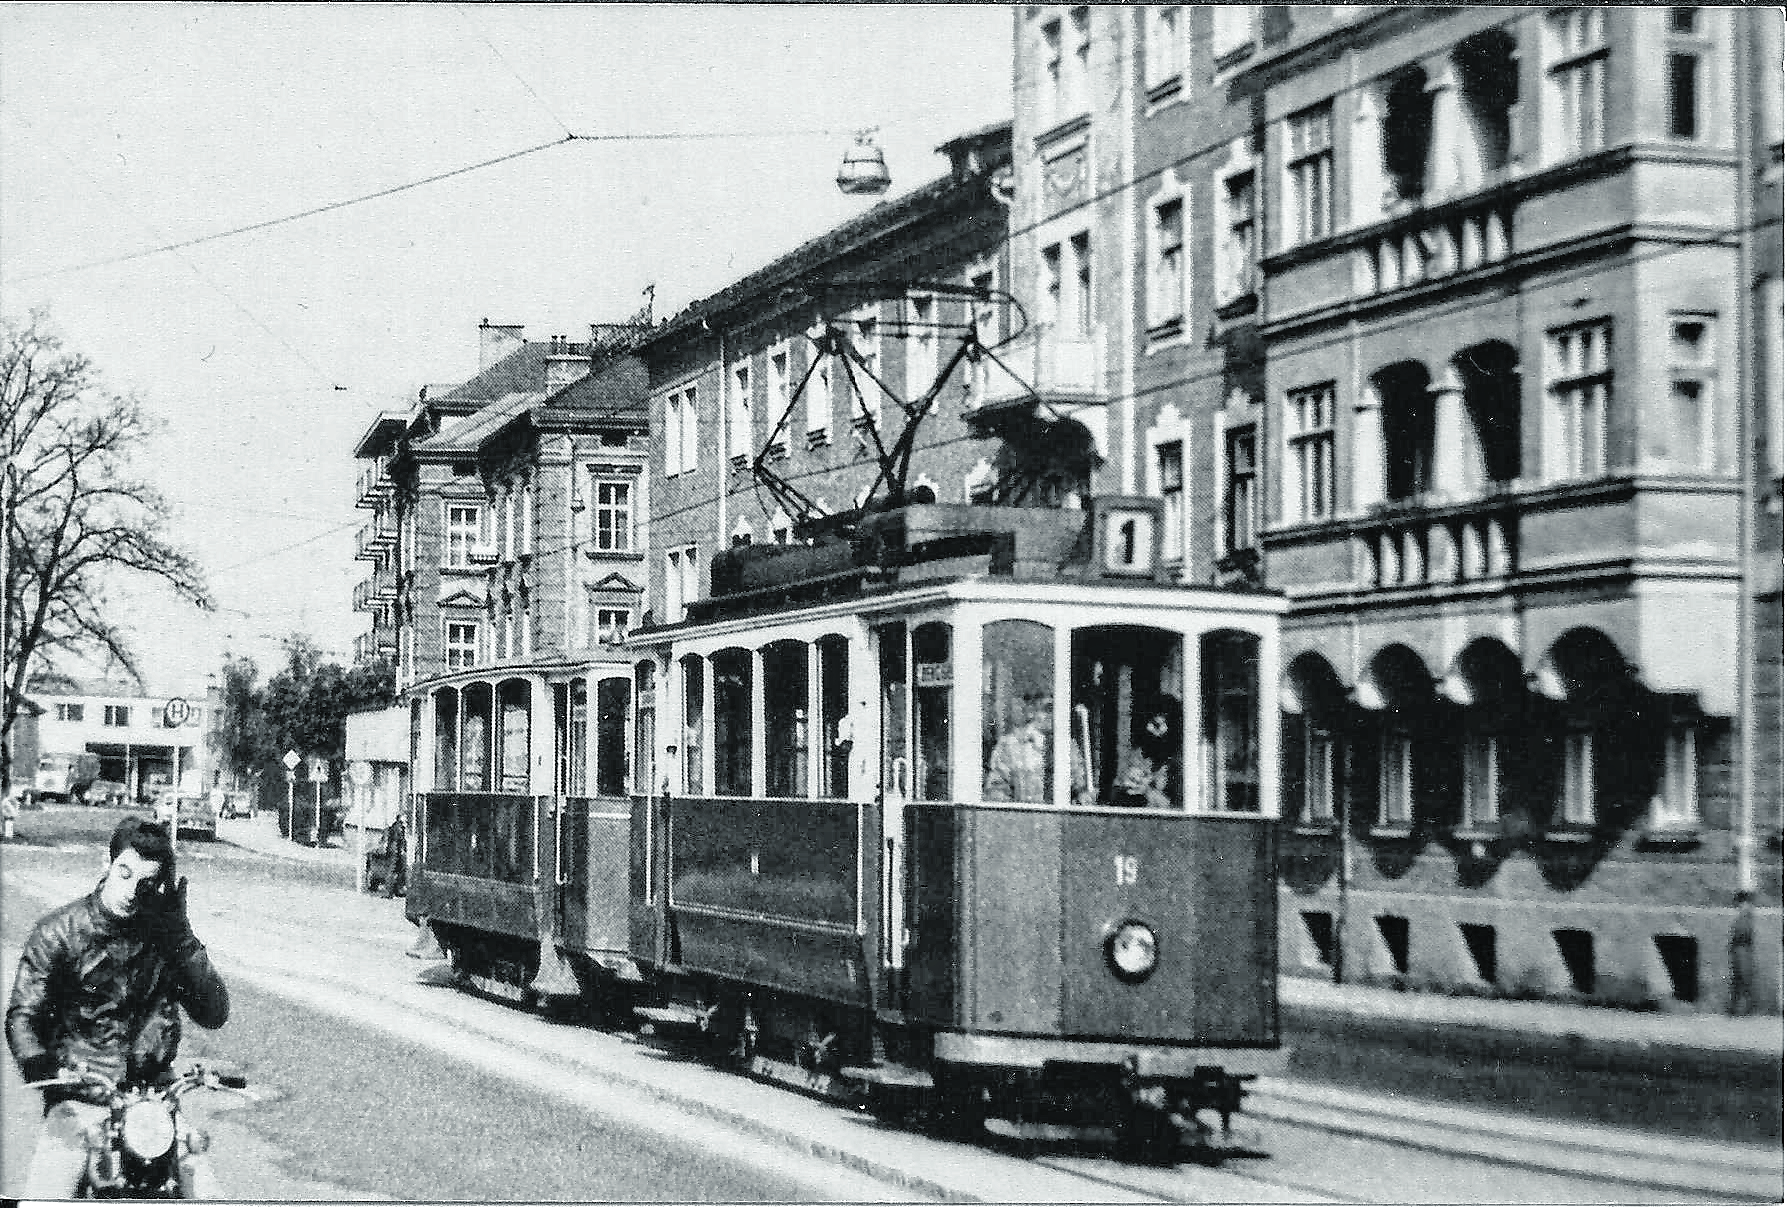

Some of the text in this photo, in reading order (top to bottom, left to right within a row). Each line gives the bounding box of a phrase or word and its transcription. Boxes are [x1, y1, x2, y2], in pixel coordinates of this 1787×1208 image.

[1121, 519, 1134, 564] 1
[171, 703, 184, 718] H
[1114, 855, 1138, 885] 19
